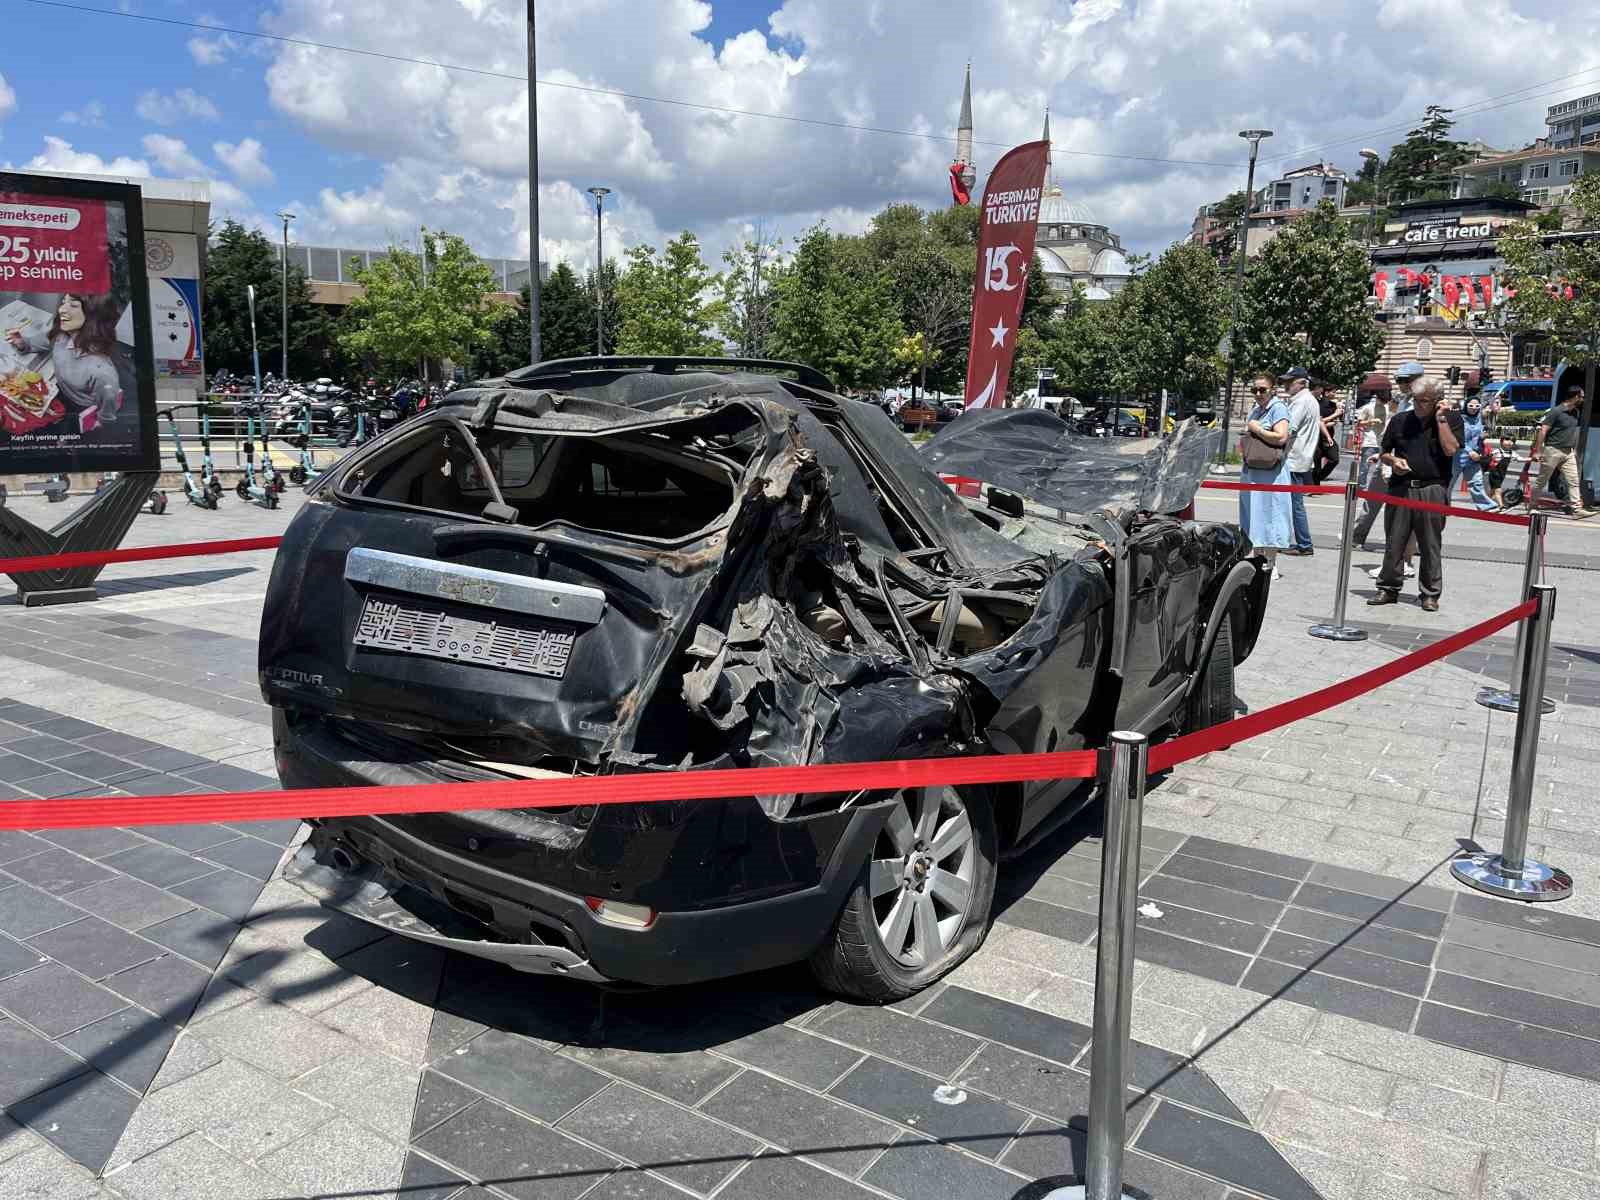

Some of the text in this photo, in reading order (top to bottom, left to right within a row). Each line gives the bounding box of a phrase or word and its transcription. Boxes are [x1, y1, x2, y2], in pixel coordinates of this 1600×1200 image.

[1405, 225, 1439, 242] cafe
[1446, 219, 1490, 239] trend
[0, 235, 79, 264] 25 yıldır
[20, 264, 83, 280] seninle
